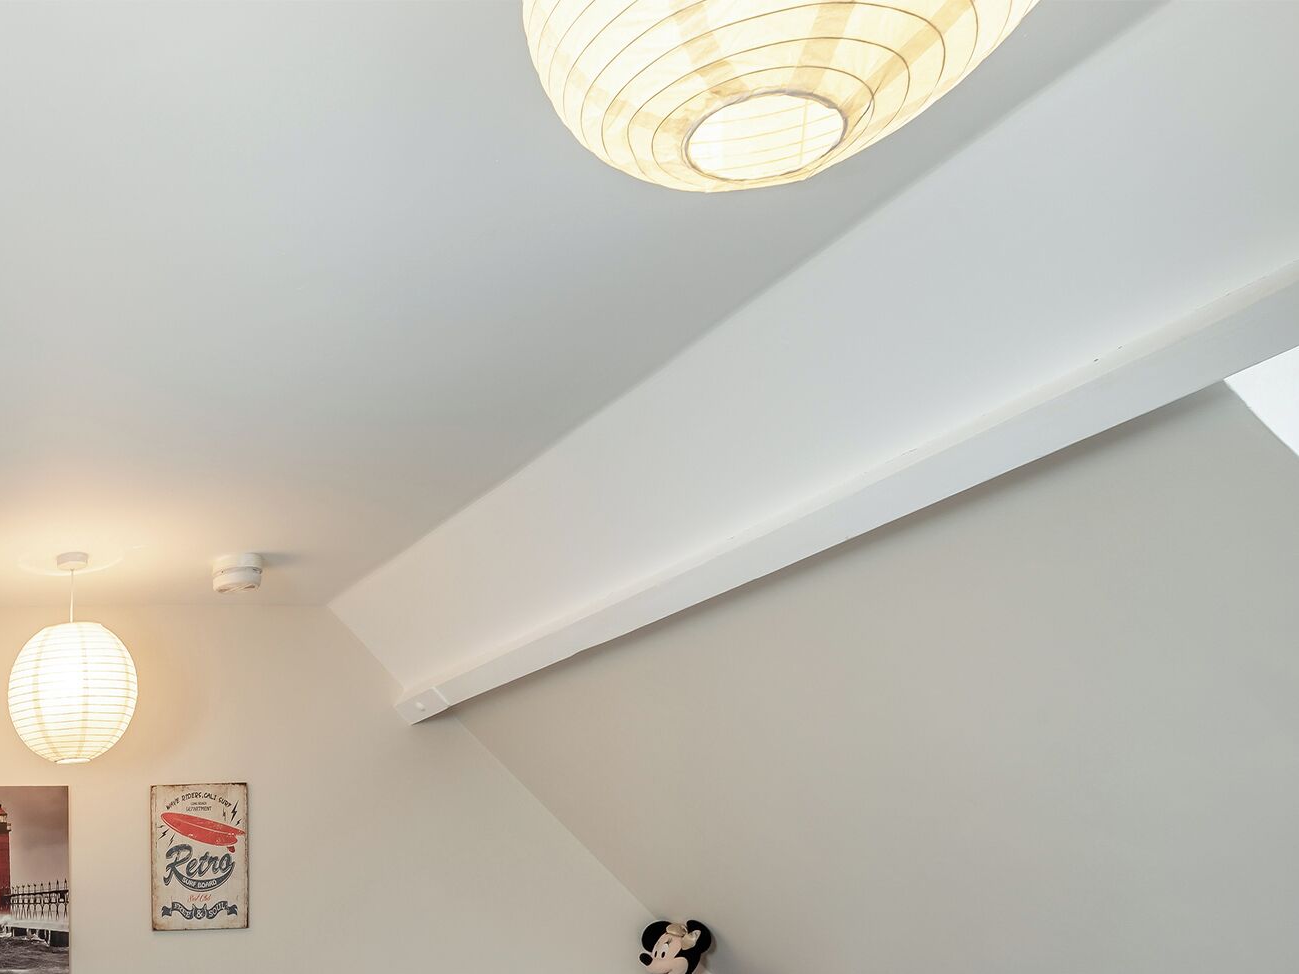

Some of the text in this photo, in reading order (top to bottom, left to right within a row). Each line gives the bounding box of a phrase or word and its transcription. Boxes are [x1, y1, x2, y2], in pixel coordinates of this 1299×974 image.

[163, 844, 235, 886] Retro
[182, 877, 217, 889] SURF BOARD
